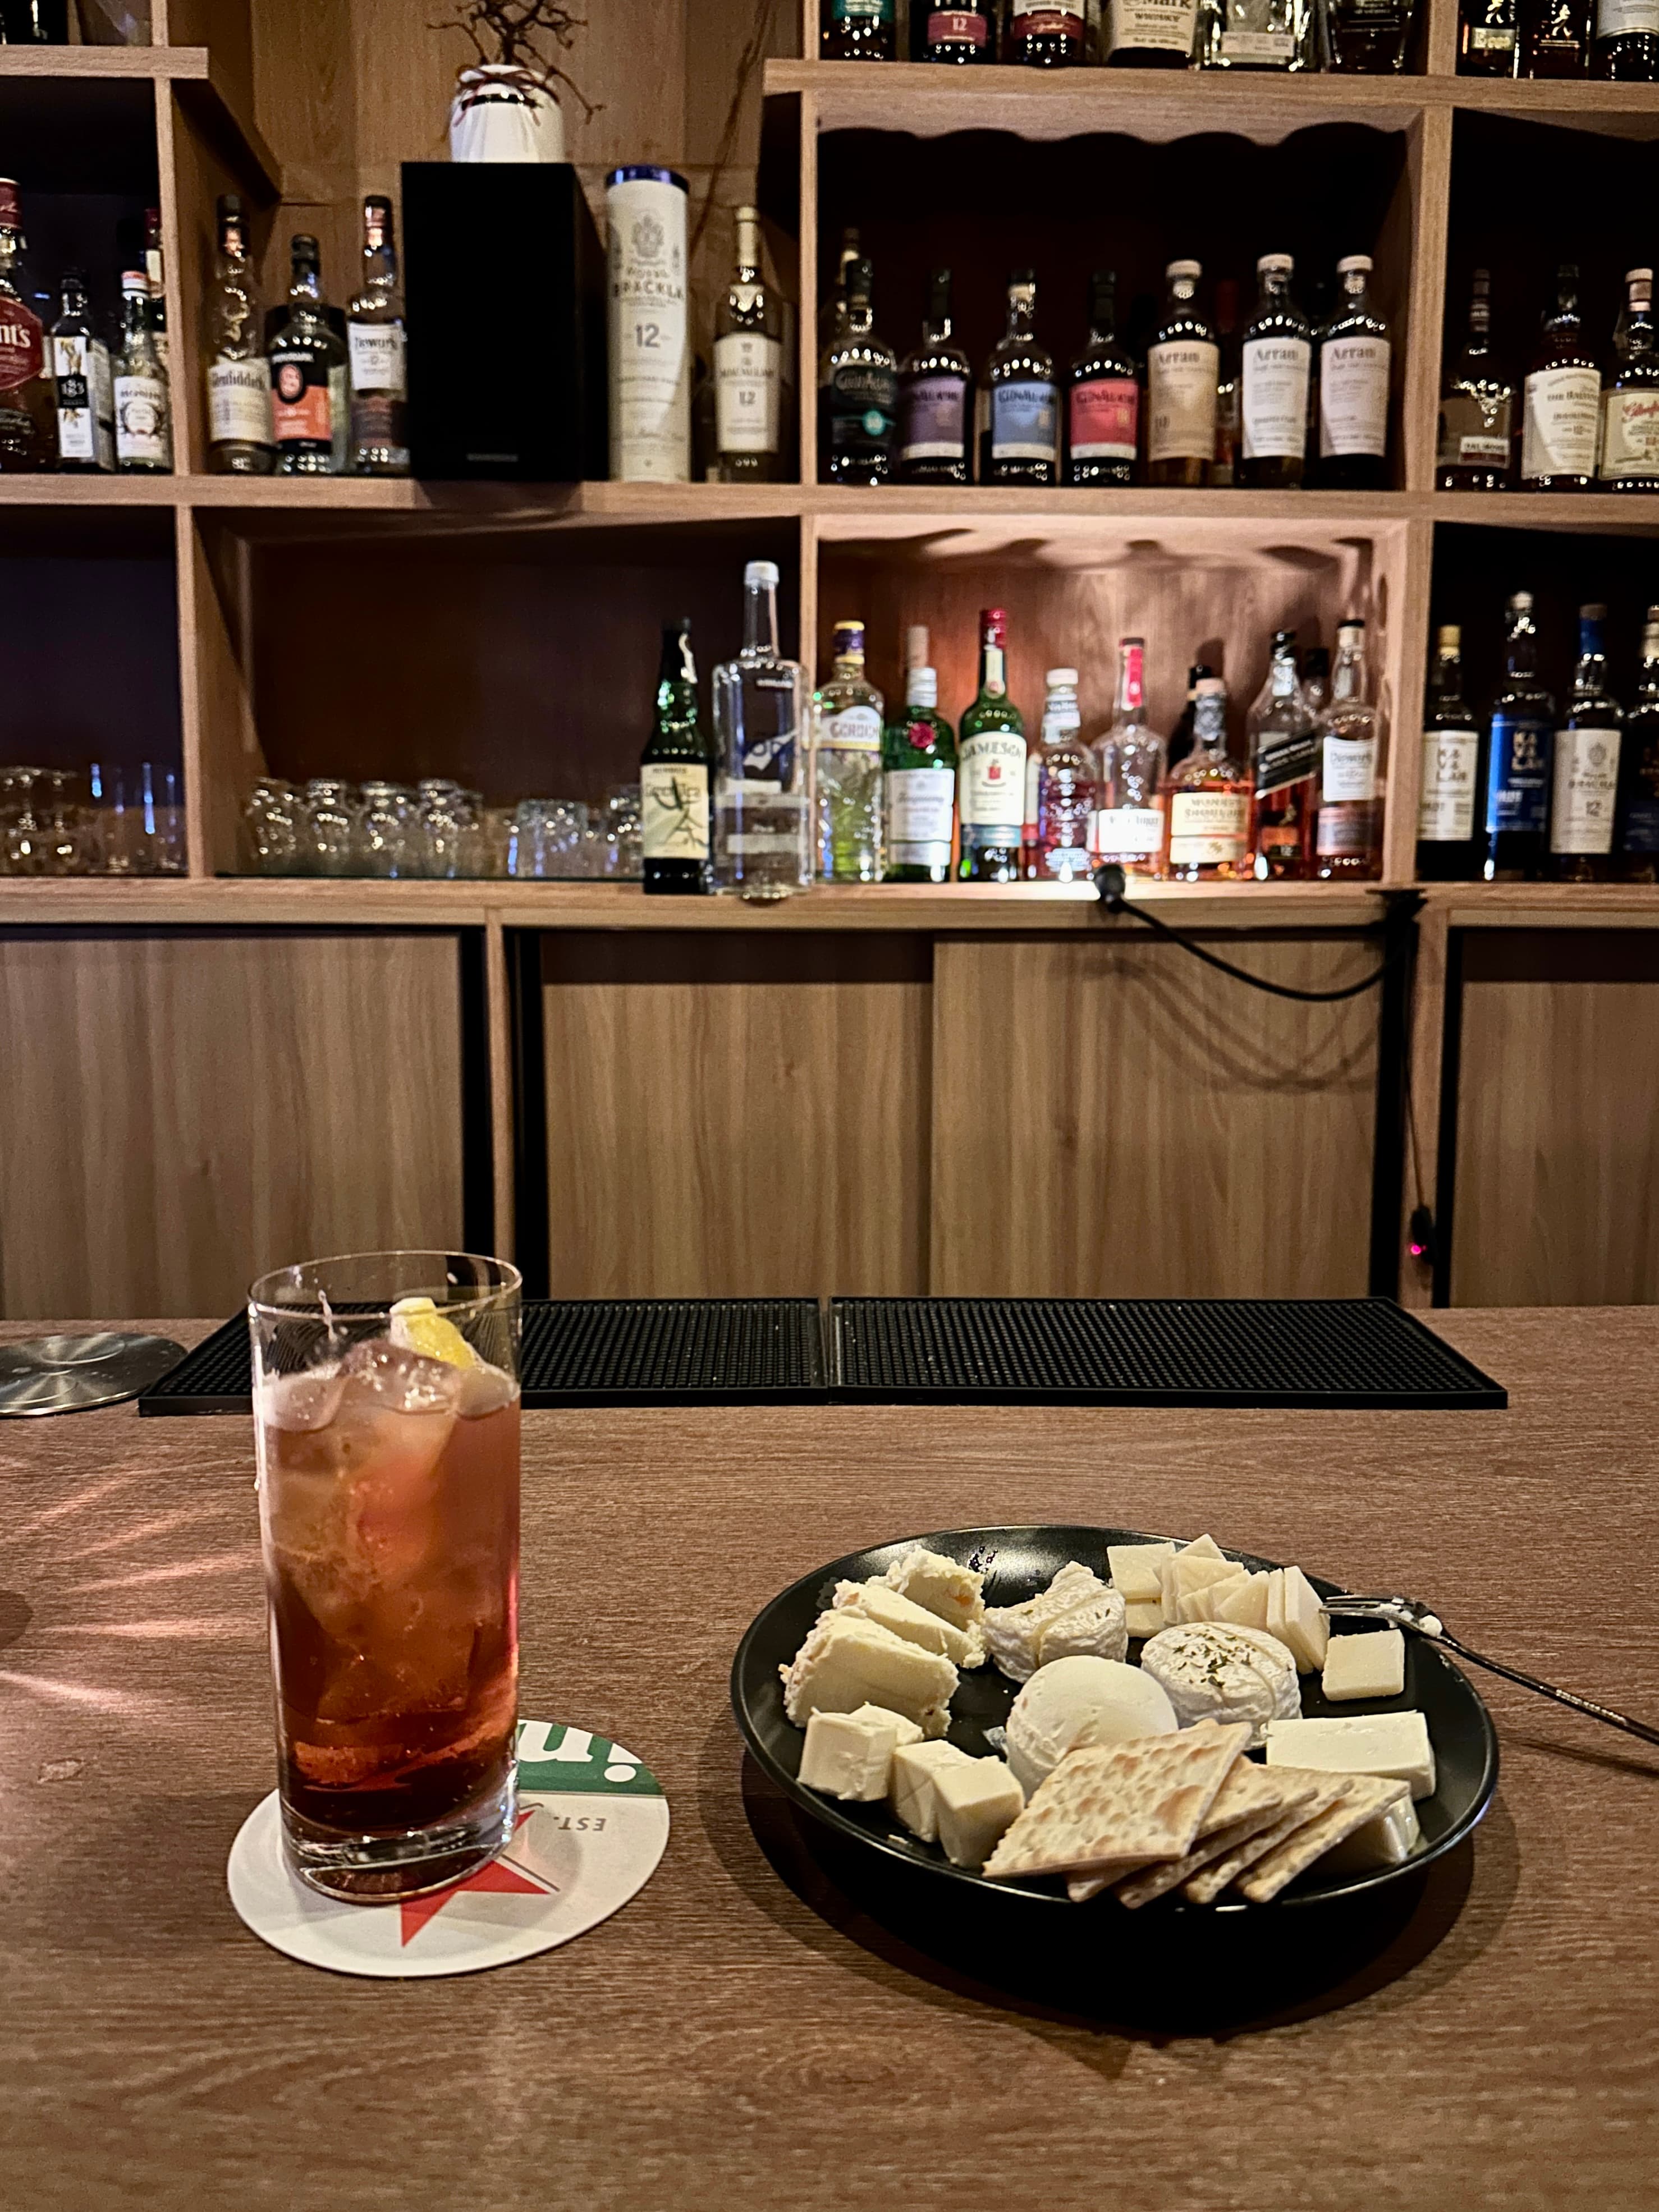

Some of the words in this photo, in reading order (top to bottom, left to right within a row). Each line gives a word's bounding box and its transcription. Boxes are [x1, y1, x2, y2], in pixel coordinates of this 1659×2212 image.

[952, 18, 967, 31] 12
[635, 324, 660, 348] 12
[1255, 348, 1299, 361] Arran
[1332, 347, 1377, 360] Arran
[962, 741, 1023, 761] JAMESON
[553, 1816, 607, 1832] EST.
